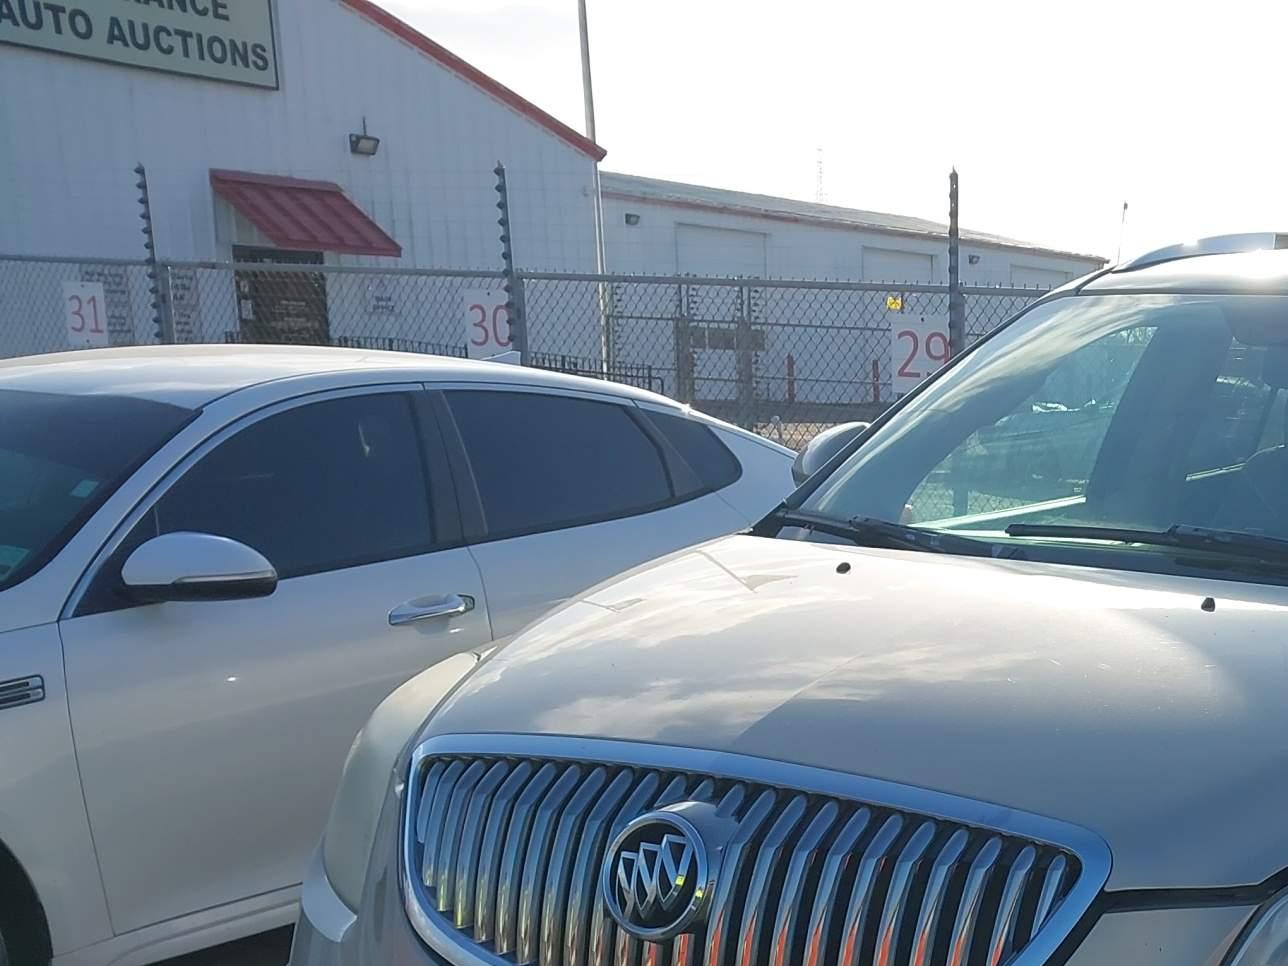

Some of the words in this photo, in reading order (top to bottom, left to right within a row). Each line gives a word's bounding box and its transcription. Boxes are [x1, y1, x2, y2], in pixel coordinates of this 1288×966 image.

[0, 0, 93, 40] AUTO
[107, 16, 269, 71] AUCTIONS
[68, 294, 104, 334] 31
[469, 304, 513, 347] 30
[896, 330, 950, 378] 29
